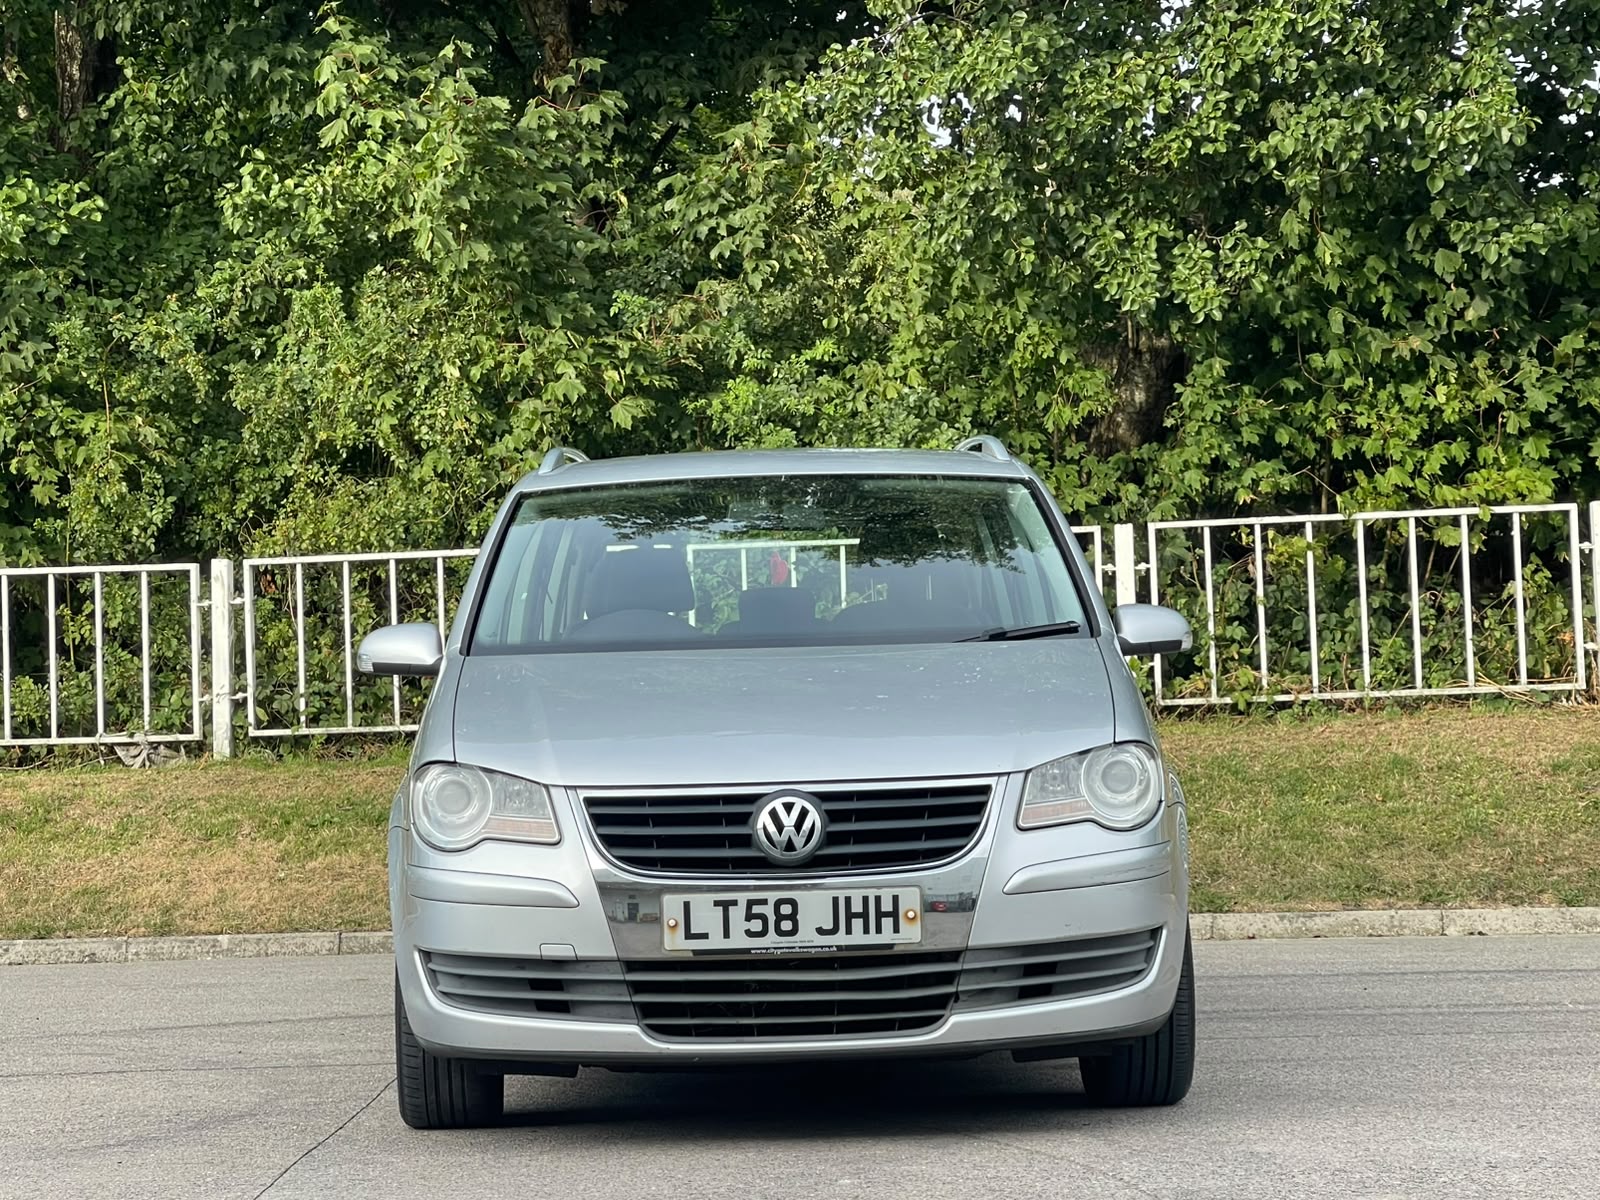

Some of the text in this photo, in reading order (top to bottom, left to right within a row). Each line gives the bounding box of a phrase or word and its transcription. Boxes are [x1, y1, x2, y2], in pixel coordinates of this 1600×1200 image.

[758, 796, 821, 858] VW
[683, 894, 900, 941] LT58 JHH
